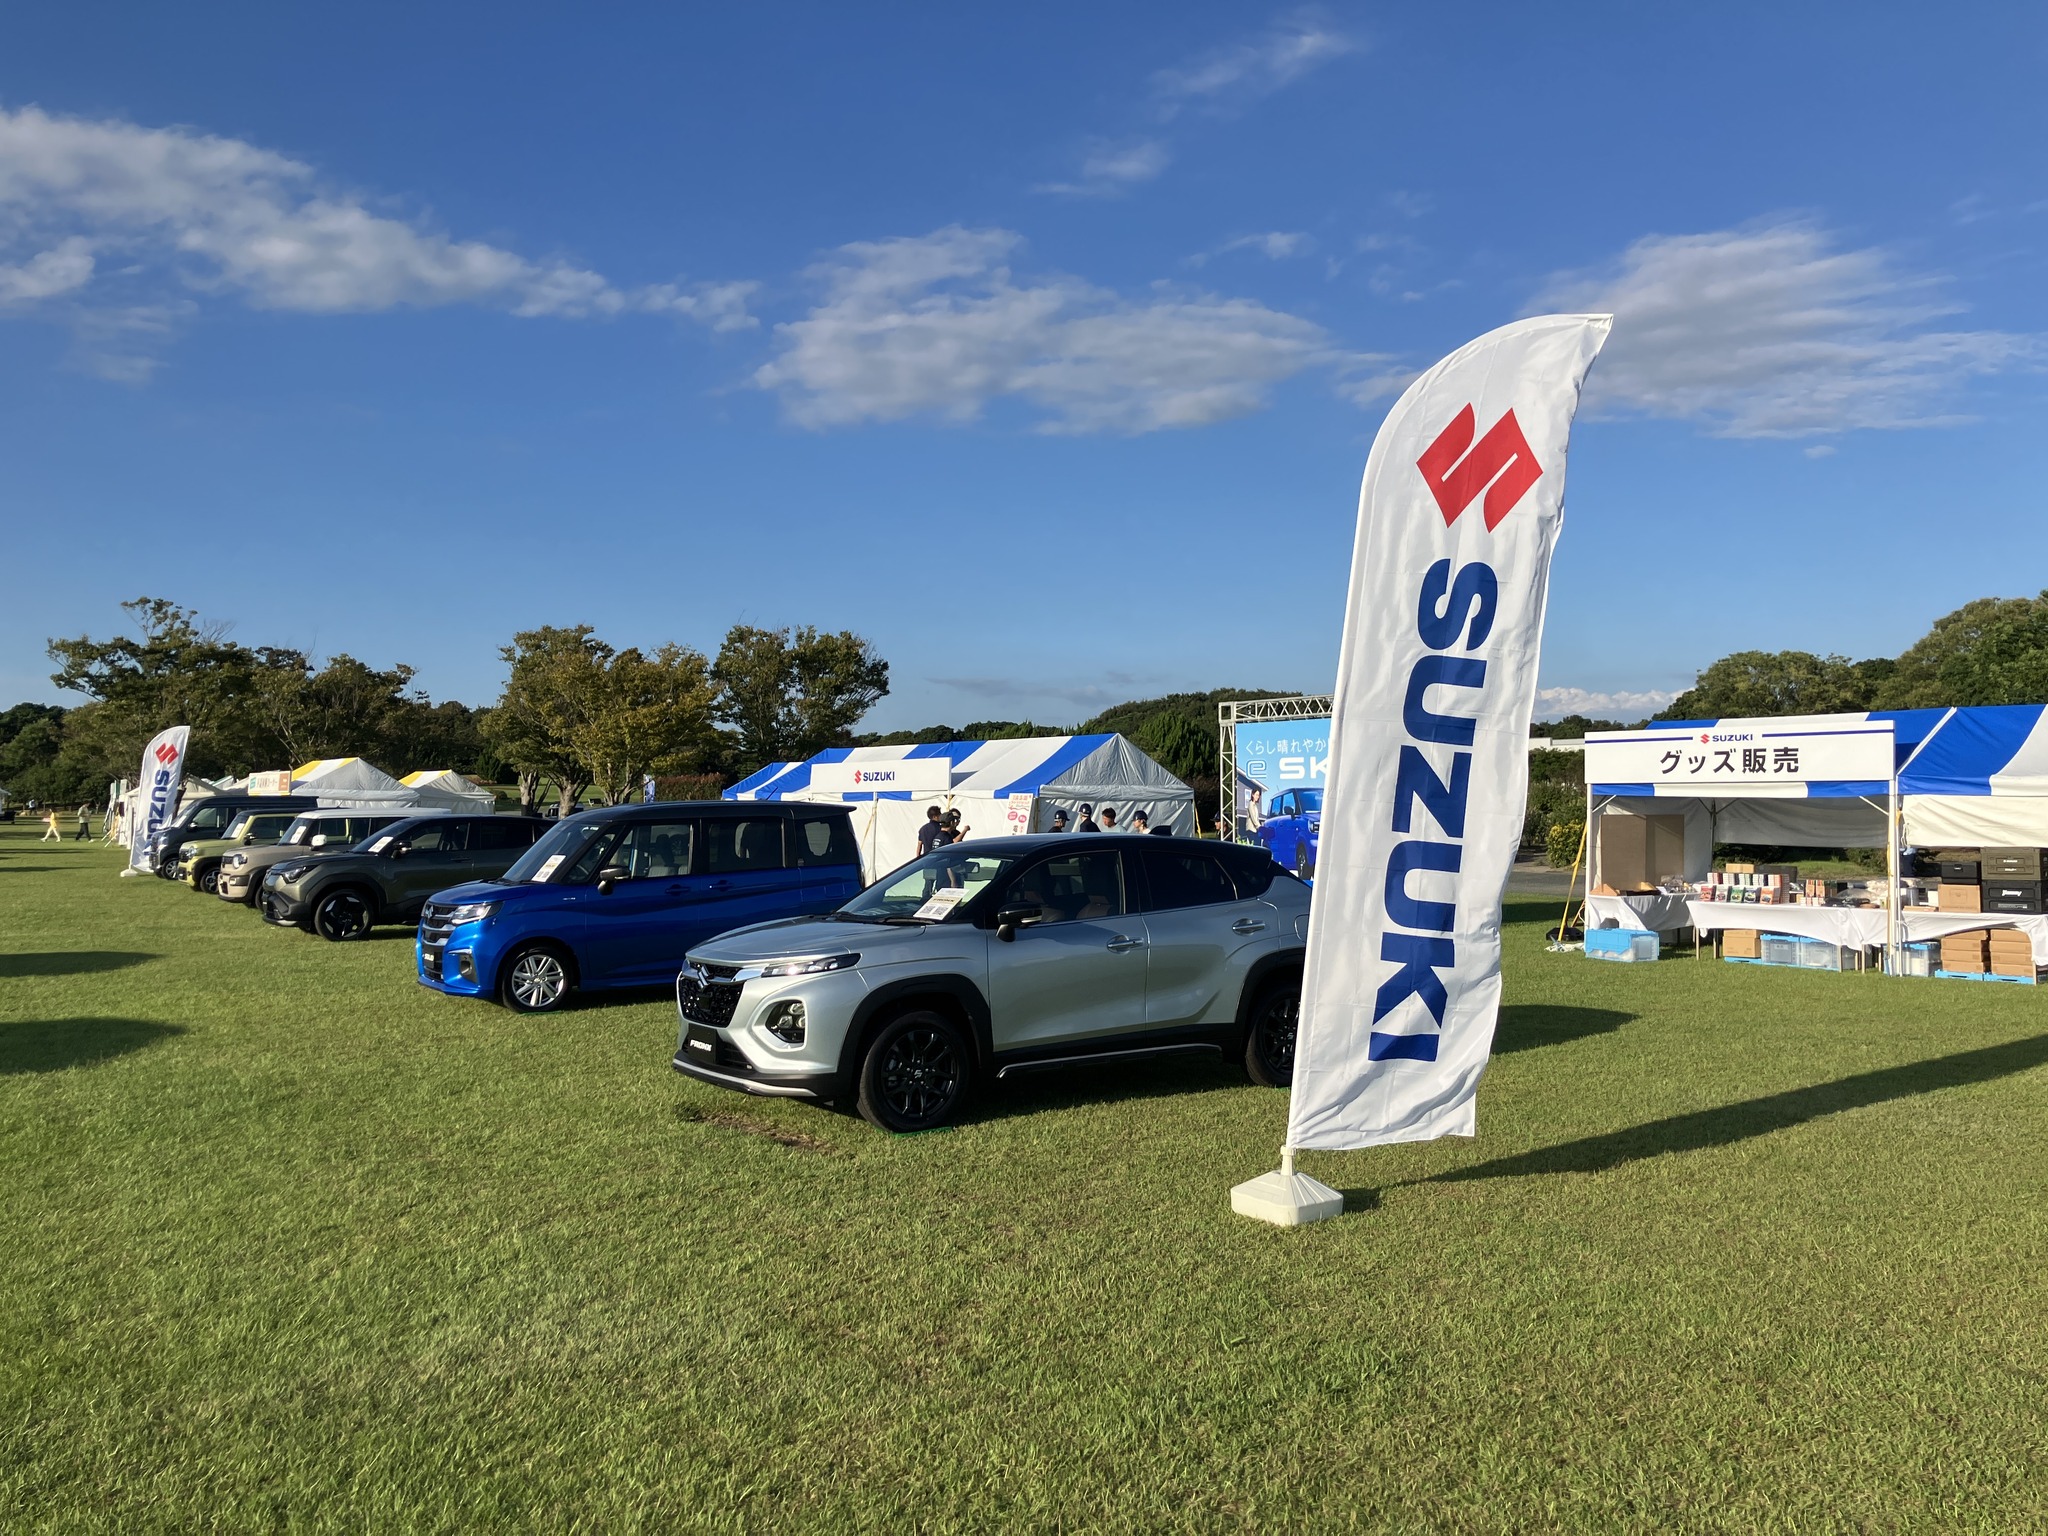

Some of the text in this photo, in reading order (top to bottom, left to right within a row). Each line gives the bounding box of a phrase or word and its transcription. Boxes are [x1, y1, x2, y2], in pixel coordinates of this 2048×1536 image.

[1712, 734, 1753, 742] SUZUKI
[1660, 747, 1799, 774] グッズ販売
[863, 771, 895, 781] SUZUKI
[144, 769, 170, 856] SUZU
[1368, 558, 1498, 1062] SUZUKI
